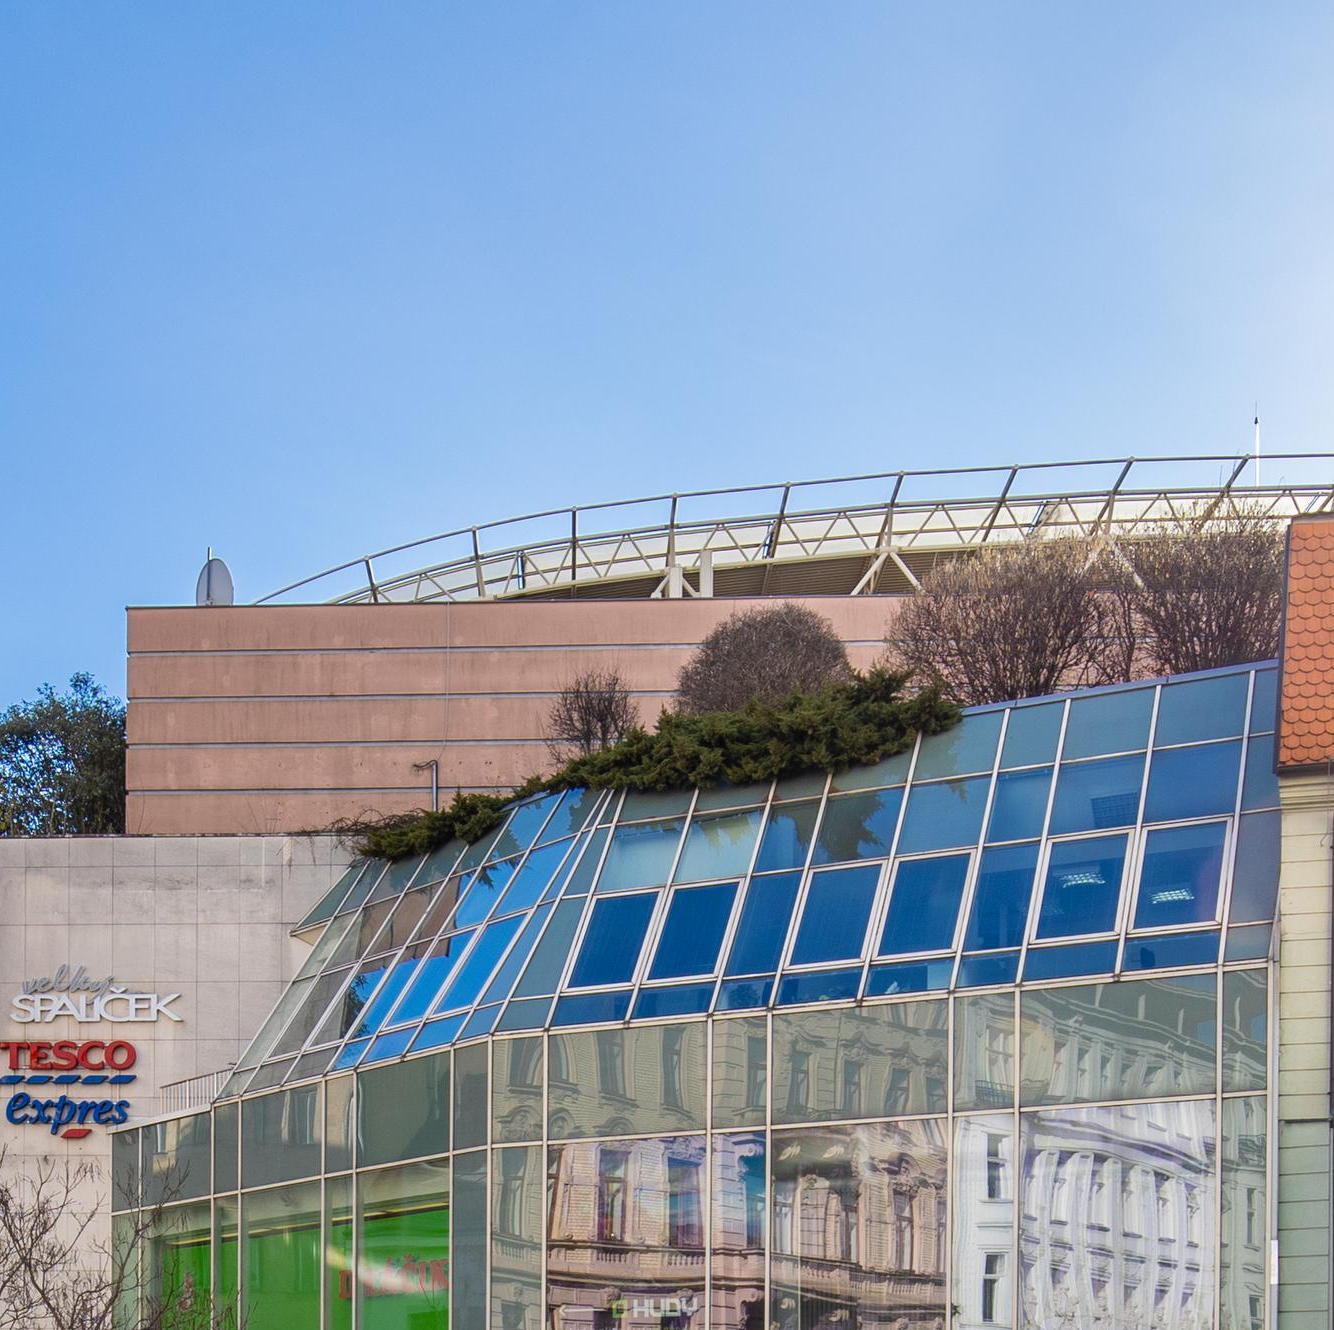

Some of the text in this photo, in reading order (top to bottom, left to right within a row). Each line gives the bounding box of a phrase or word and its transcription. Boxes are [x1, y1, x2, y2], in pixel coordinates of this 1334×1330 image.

[0, 1040, 137, 1070] TESCO
[6, 1092, 130, 1135] expres
[633, 1297, 698, 1319] HUDY
